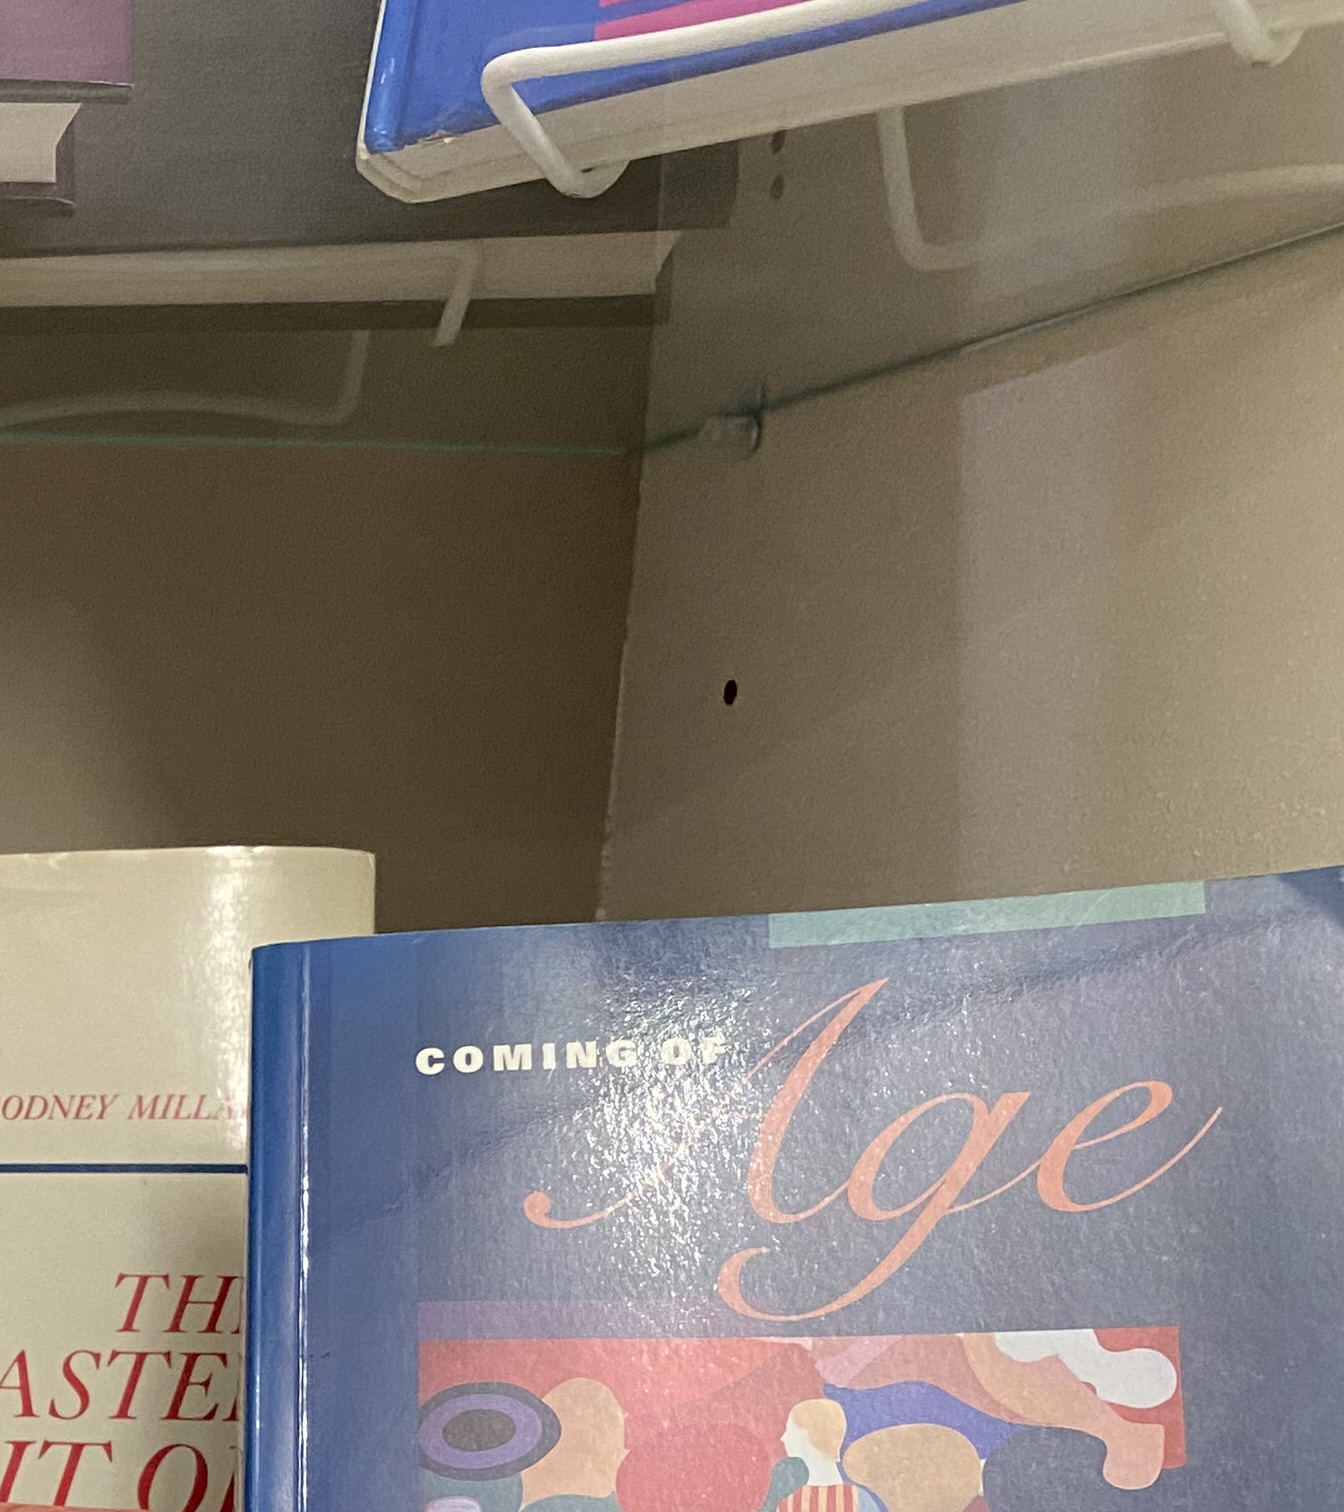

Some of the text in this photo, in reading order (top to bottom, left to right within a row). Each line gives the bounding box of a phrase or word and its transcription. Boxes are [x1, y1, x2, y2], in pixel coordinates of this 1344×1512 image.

[415, 1038, 726, 1075] COMING OF
[523, 977, 1223, 1322] Age
[114, 1272, 241, 1334] TH
